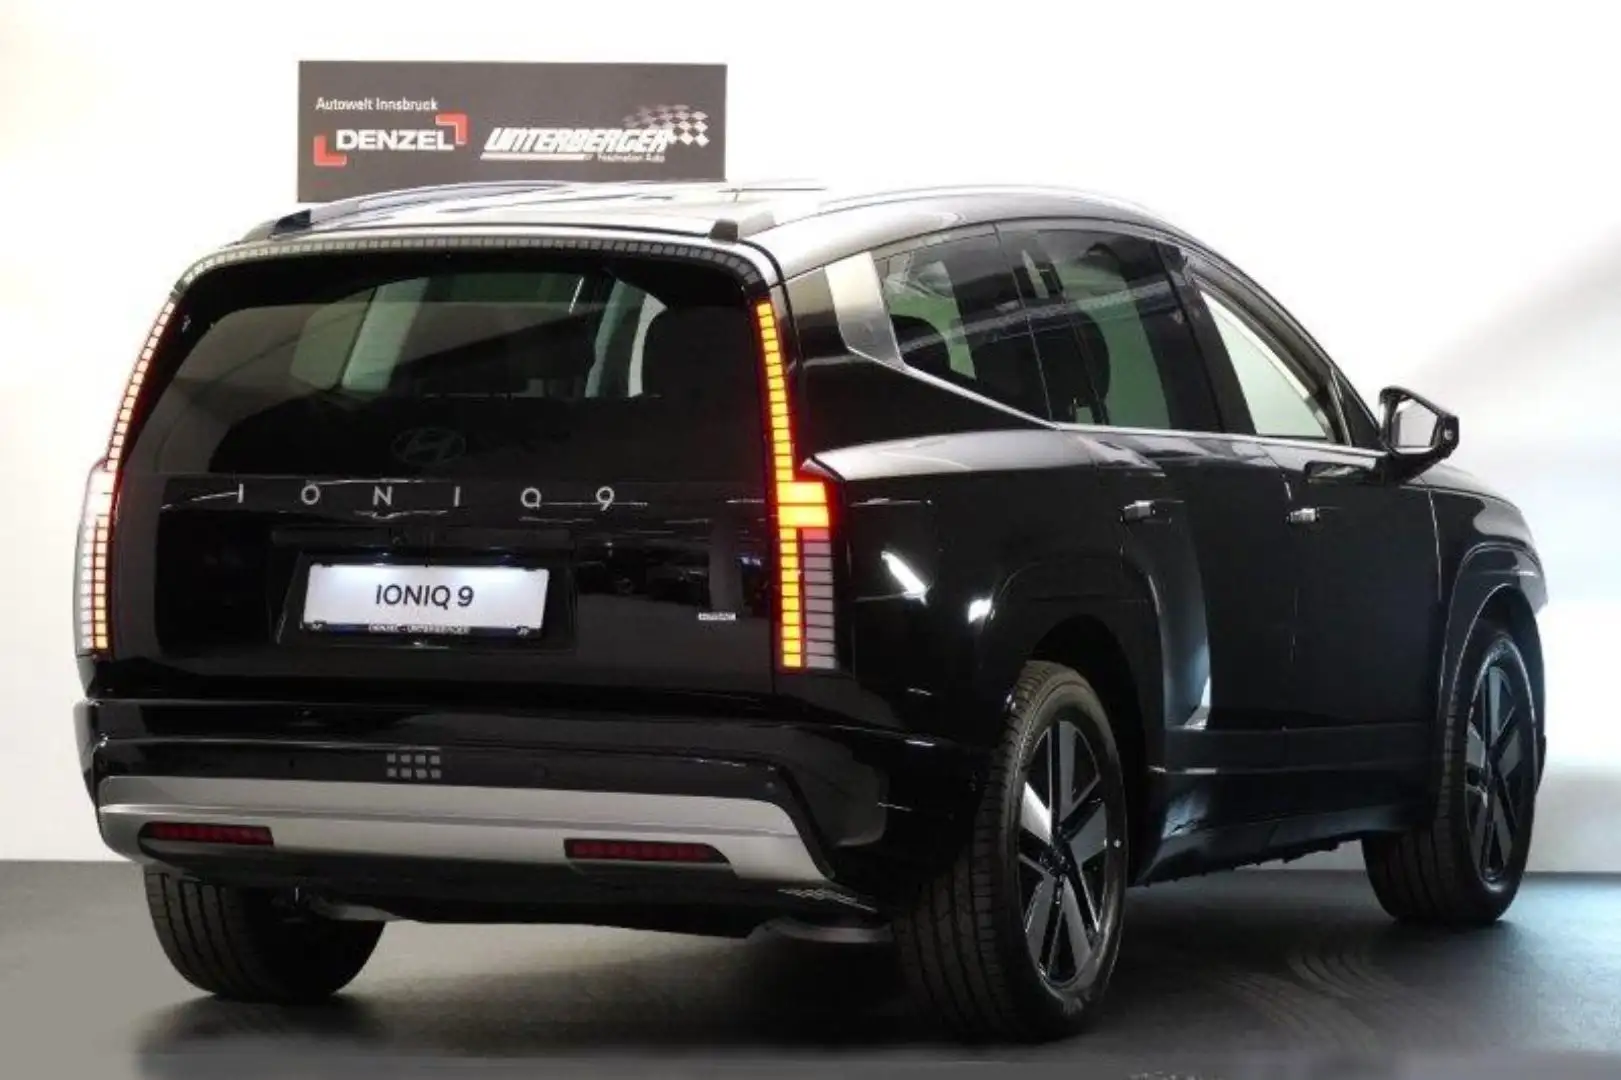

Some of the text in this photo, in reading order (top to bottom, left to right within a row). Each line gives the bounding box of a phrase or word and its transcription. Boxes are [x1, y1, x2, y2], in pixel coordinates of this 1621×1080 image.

[315, 97, 438, 111] Autowelt Innsbruck
[336, 129, 455, 151] DENZEL
[376, 584, 474, 610] IONIQ 9
